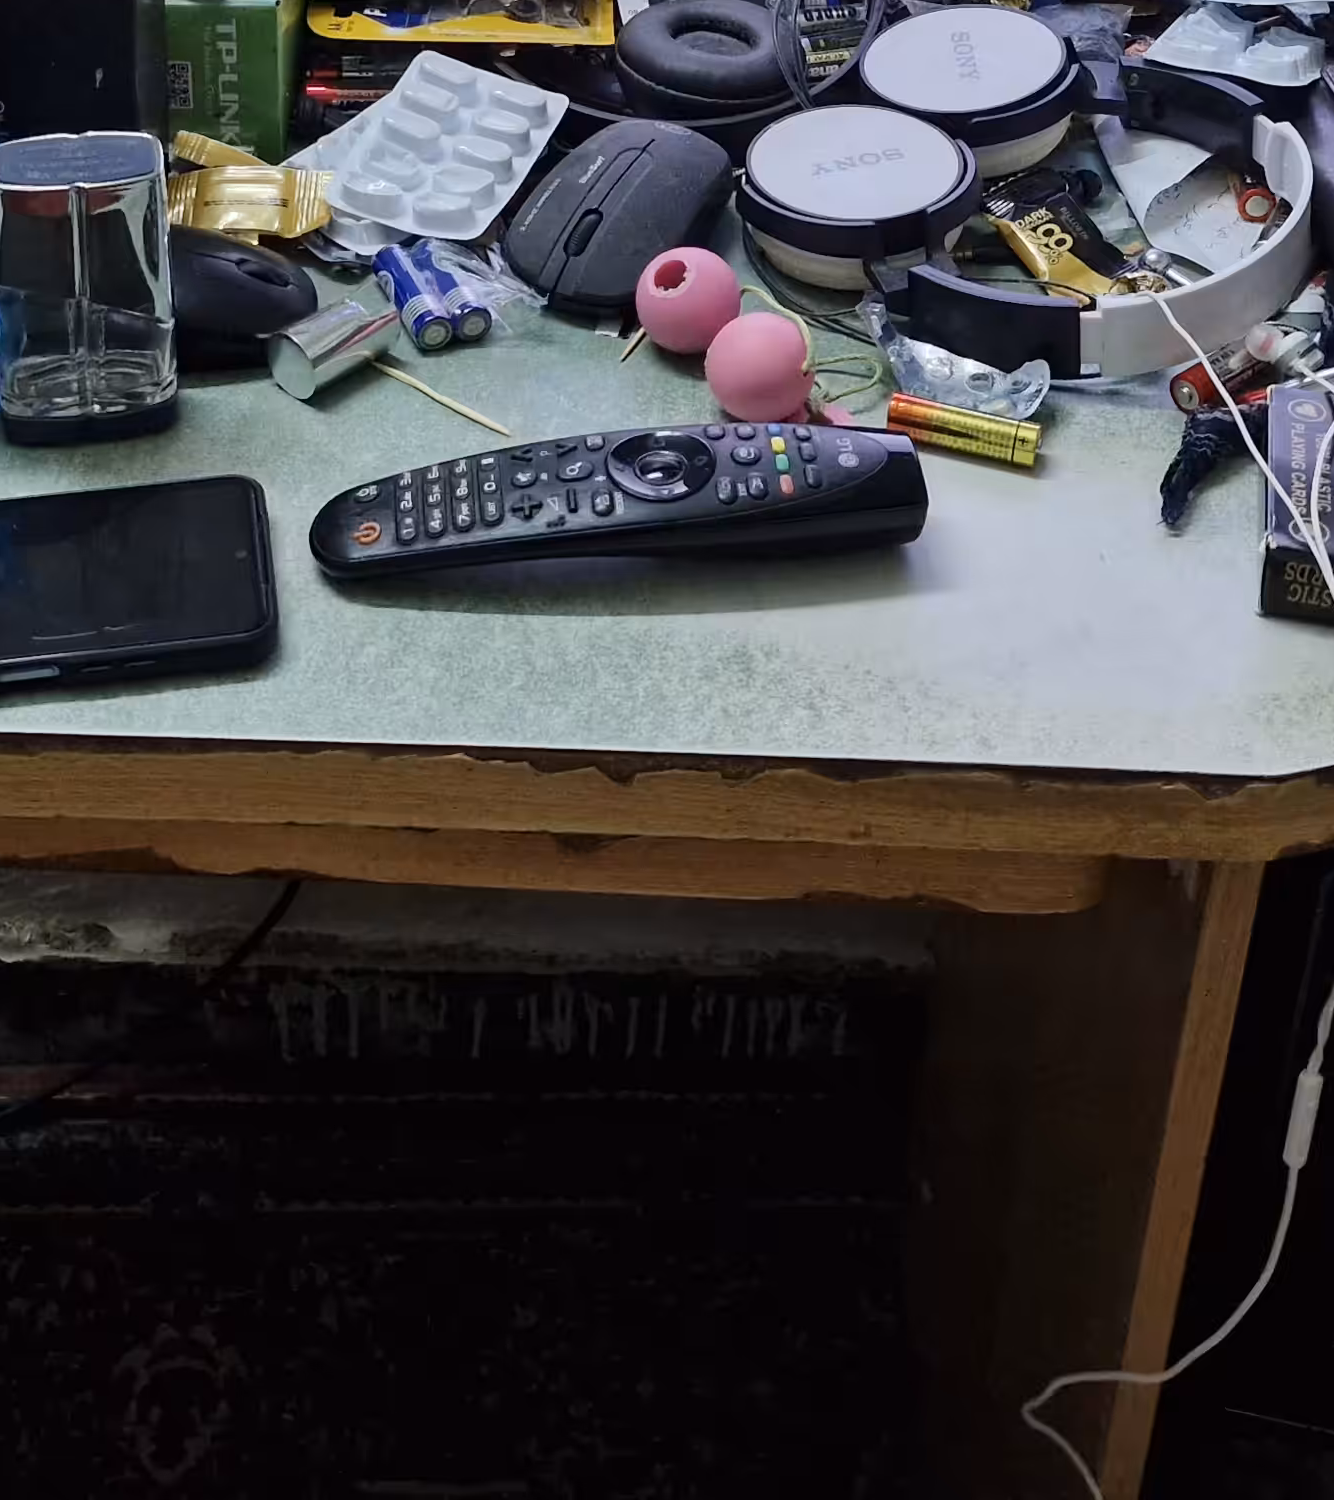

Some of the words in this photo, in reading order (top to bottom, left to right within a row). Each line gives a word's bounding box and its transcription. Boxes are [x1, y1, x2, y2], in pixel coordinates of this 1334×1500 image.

[951, 30, 981, 82] SONY
[215, 18, 242, 147] TP-LINK
[811, 146, 906, 177] SONY
[1015, 206, 1055, 229] DARK
[836, 436, 853, 452] LG
[1291, 422, 1307, 470] PLAYING
[1291, 471, 1308, 520] CARDS
